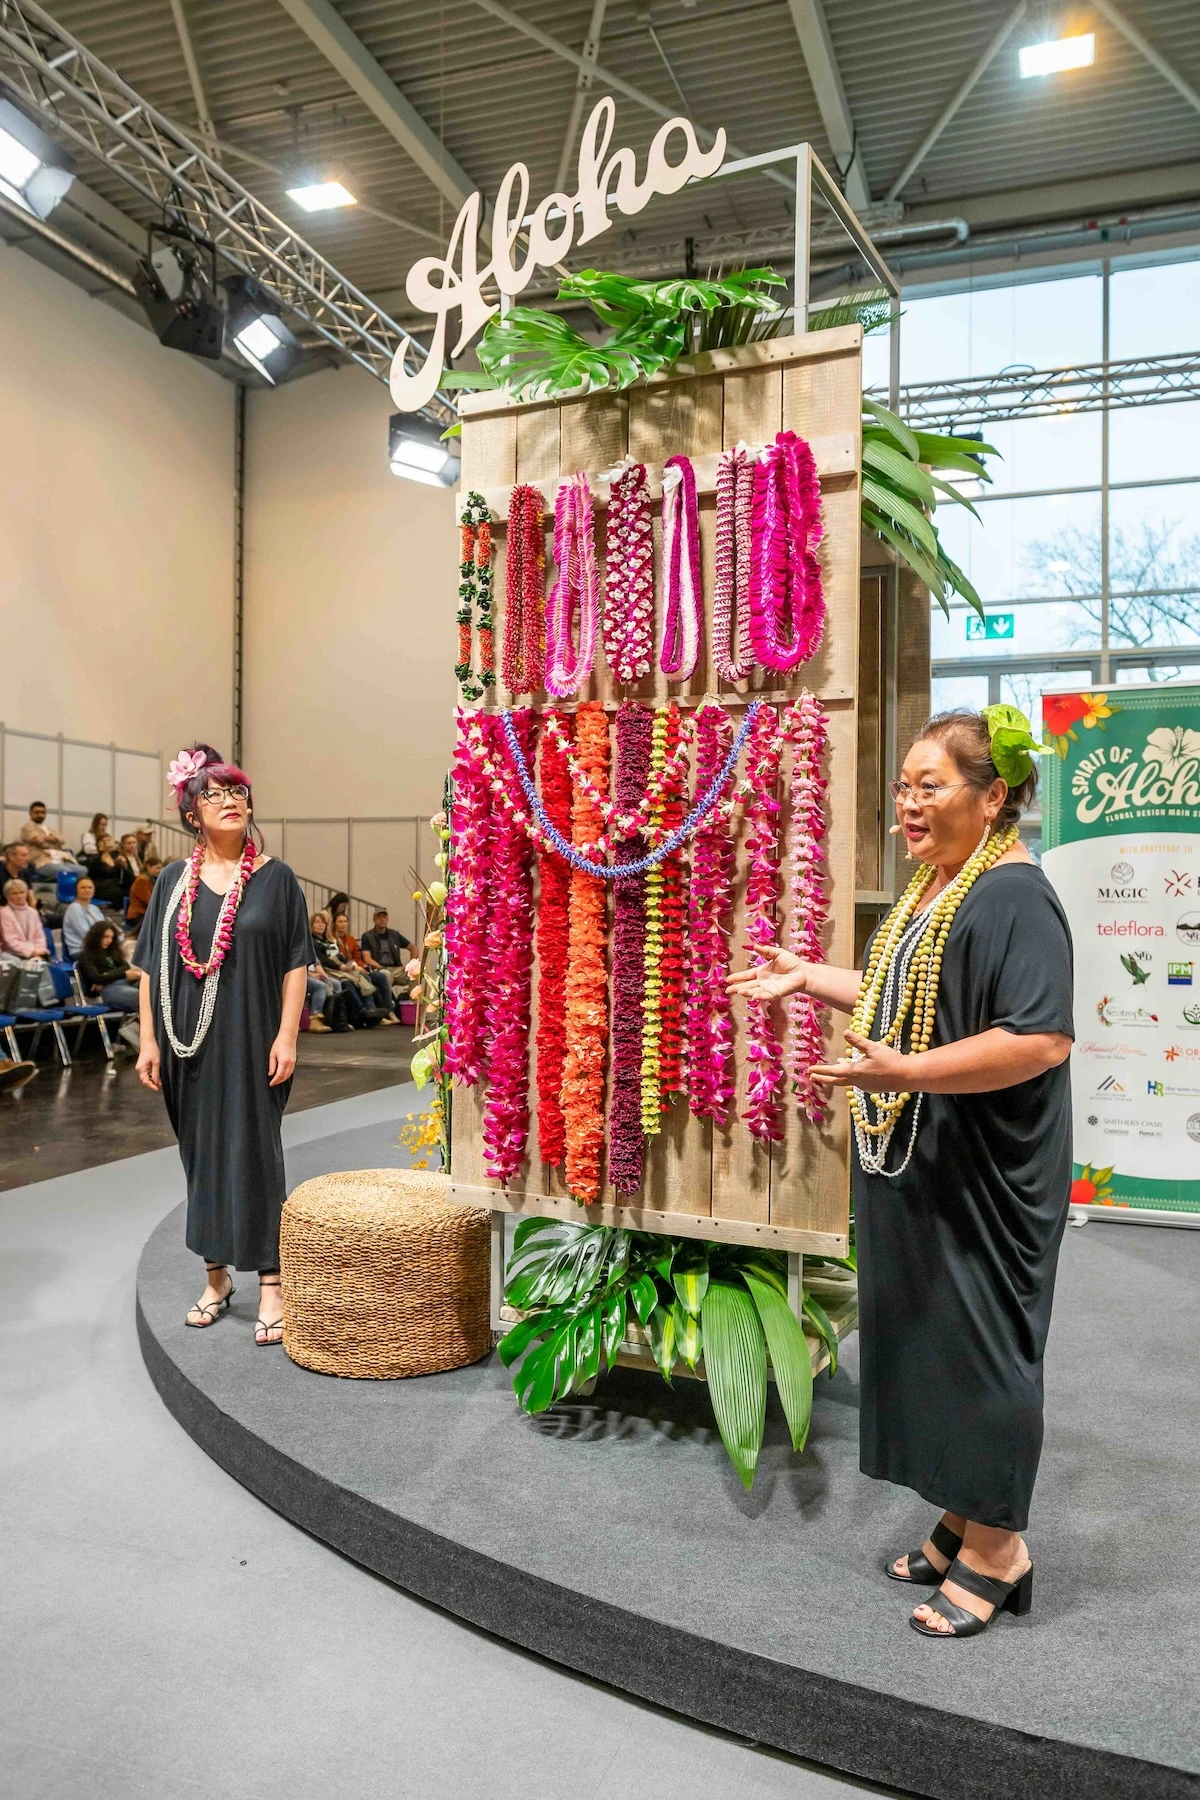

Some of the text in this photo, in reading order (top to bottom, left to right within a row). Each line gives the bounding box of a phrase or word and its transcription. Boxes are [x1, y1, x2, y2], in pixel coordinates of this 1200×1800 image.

[389, 95, 727, 412] Aloha
[1072, 746, 1132, 796] SPIRIT OF
[1076, 760, 1200, 824] Aloh
[1105, 811, 1134, 823] FLORAL
[1136, 809, 1166, 817] DESIGN
[1168, 808, 1191, 817] MAIN
[1098, 888, 1148, 899] MAGIC
[1097, 920, 1164, 936] teleflora
[1169, 963, 1191, 975] IPM
